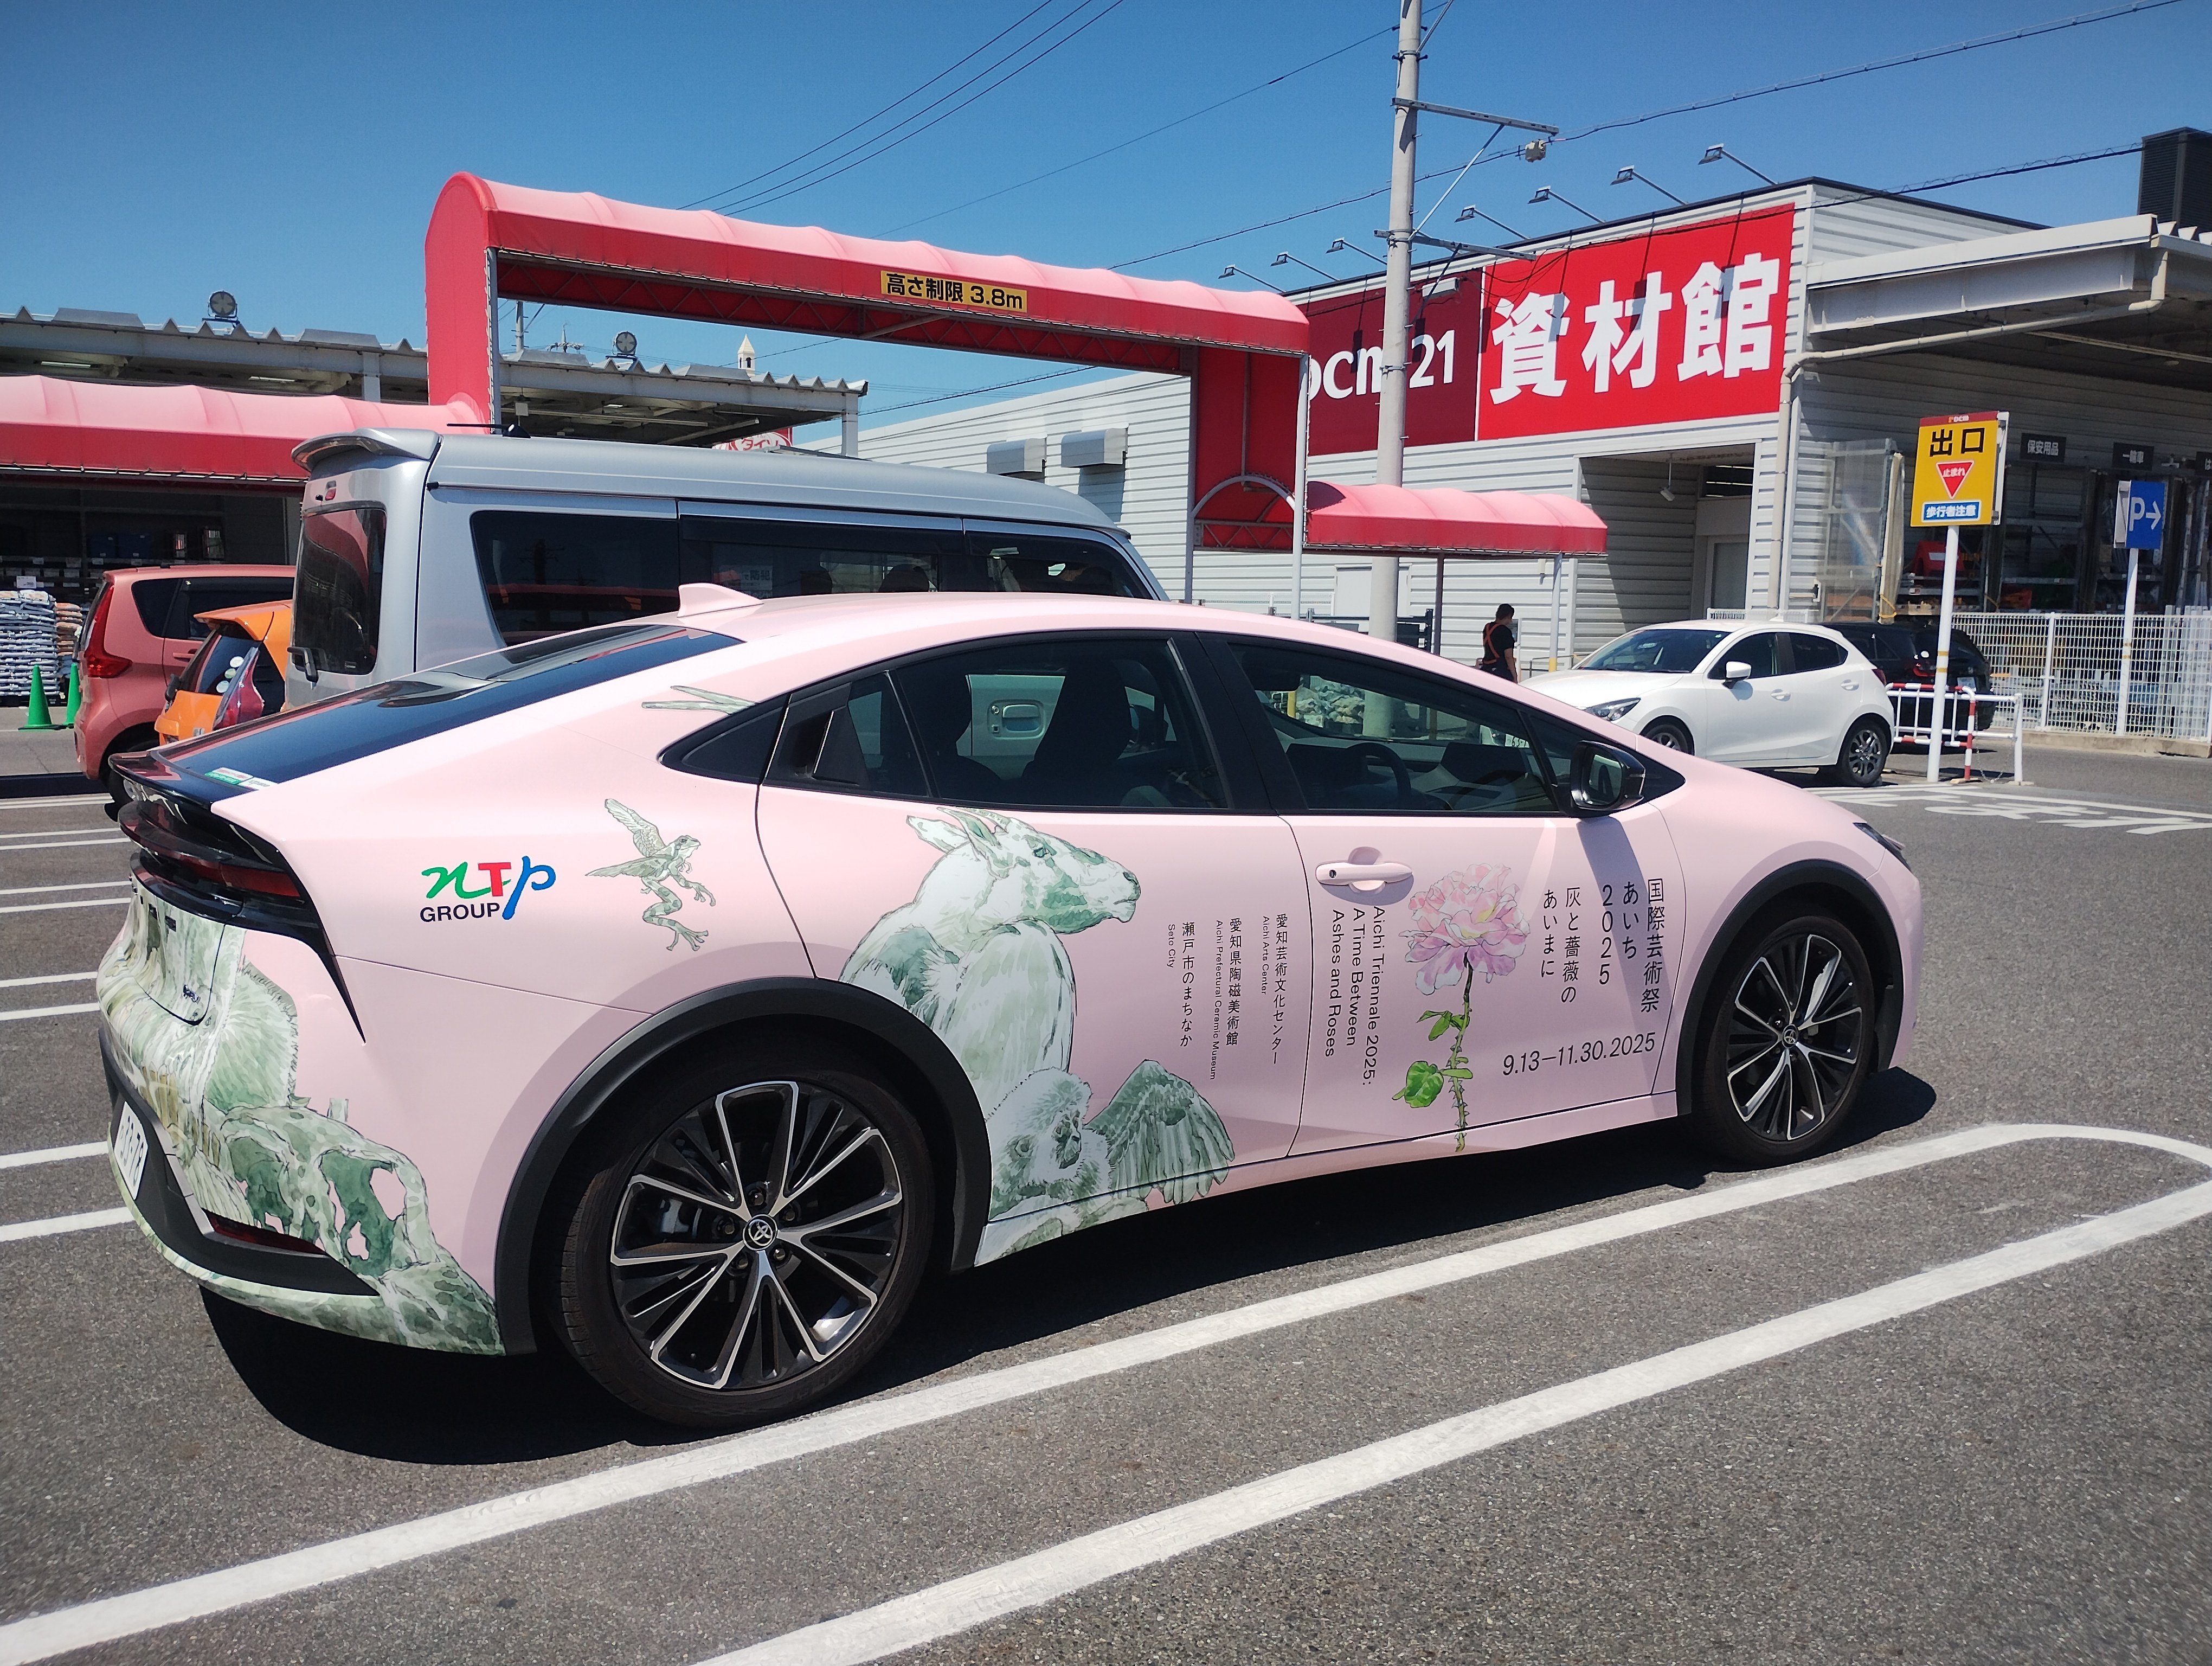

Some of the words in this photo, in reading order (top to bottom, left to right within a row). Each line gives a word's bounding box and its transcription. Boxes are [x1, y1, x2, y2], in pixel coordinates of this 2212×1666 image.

[886, 273, 963, 303] 高さ制限
[970, 285, 1023, 310] 3.8m
[1489, 252, 1780, 405] 資材館
[1409, 330, 1455, 390] 21
[1930, 427, 1985, 457] 出口
[1943, 467, 1965, 478] 止まれ
[1926, 504, 1977, 518] 歩行者注意
[2129, 497, 2145, 532] P
[420, 902, 500, 922] GROUP
[1332, 909, 1345, 964] Ashes
[1353, 908, 1366, 921] A
[1373, 906, 1385, 949] Aichi
[1541, 889, 1557, 977] あいまに
[1599, 884, 1613, 985] 2025
[1622, 881, 1639, 959] あいち
[1167, 949, 1176, 968] City
[1352, 924, 1365, 966] Time
[1561, 887, 1581, 1003] 灰と薔薇の
[1641, 878, 1665, 1013] 国際芸術祭
[1180, 922, 1195, 1047] 瀬戸市のまちなか
[1214, 946, 1223, 998] Prefectural
[1226, 918, 1242, 1046] 愛知県陶磁美術館
[1261, 964, 1269, 995] Center
[1271, 913, 1288, 1065] 愛知芸術文化センター
[1329, 969, 1342, 999] and
[1368, 953, 1385, 1030] Triennale
[1213, 1000, 1222, 1039] Ceramic
[1325, 1004, 1341, 1057] Roses
[1346, 971, 1364, 1046] Between
[1210, 1041, 1220, 1080] Museum
[1362, 1034, 1379, 1085] 2025:
